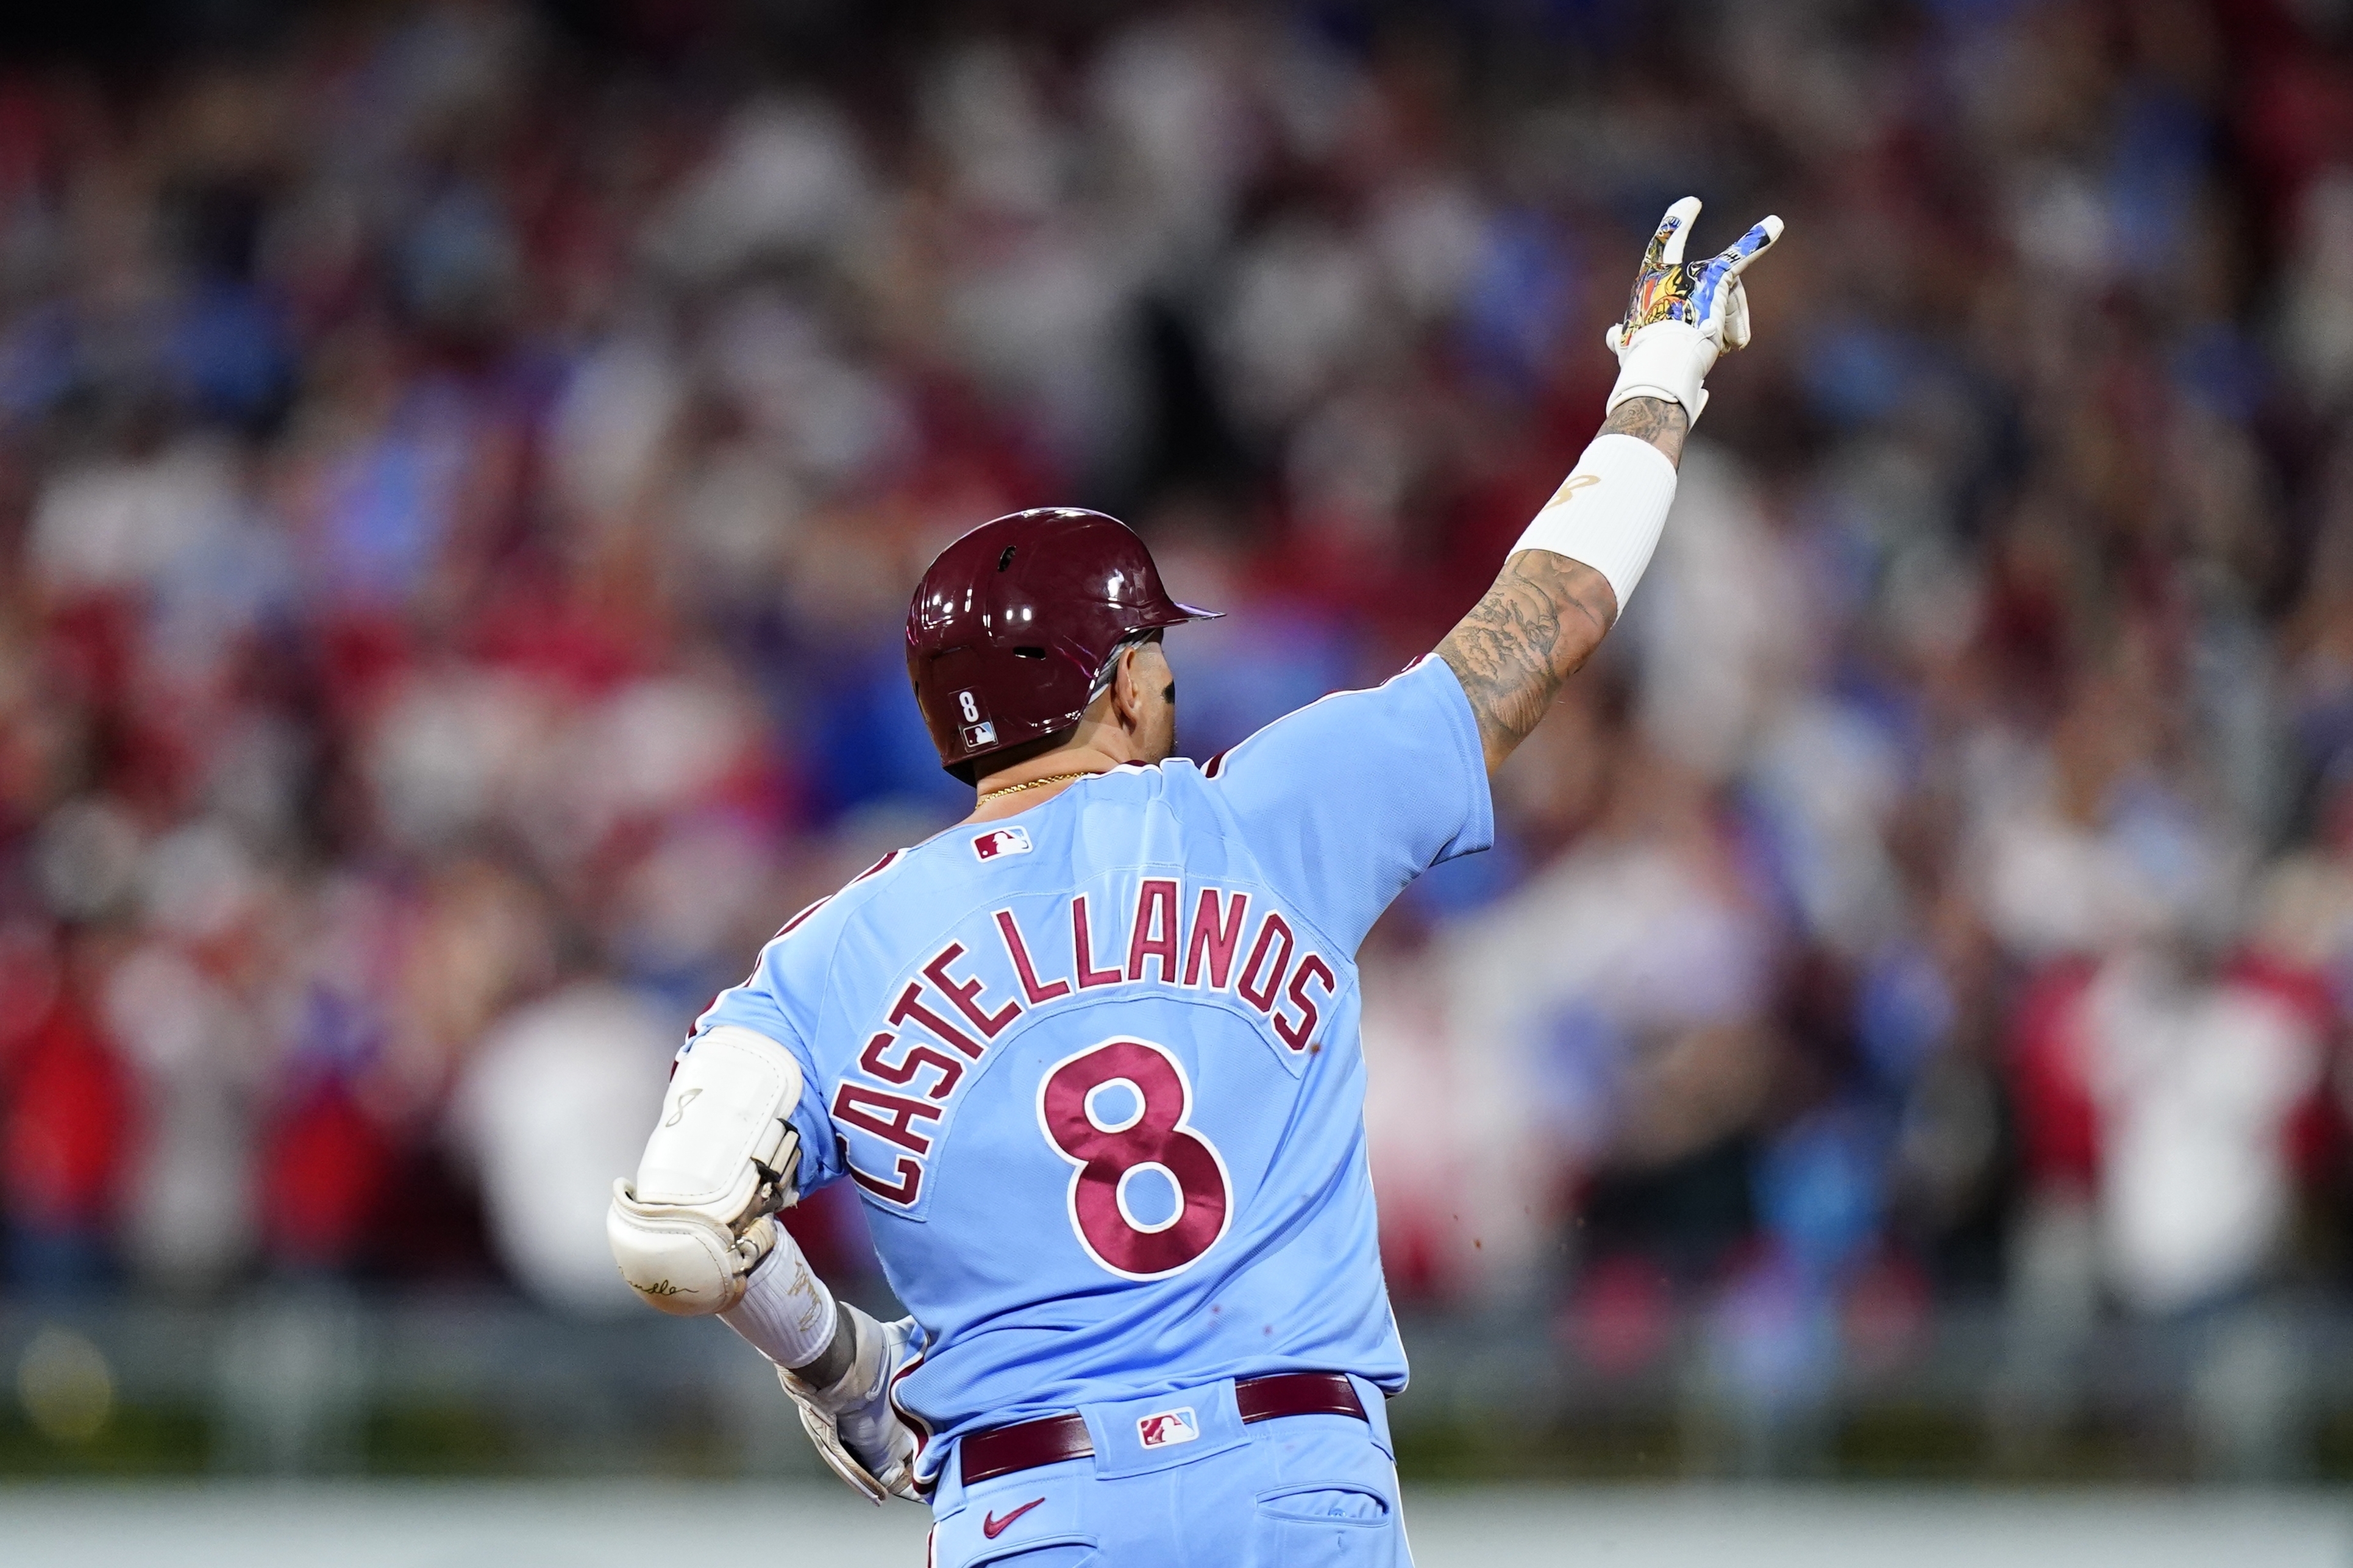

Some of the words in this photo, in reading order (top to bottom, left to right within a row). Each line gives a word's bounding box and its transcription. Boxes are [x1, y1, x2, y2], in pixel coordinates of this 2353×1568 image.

[959, 691, 979, 722] 8
[830, 876, 1336, 1210] CASTELLANOS
[1036, 1035, 1234, 1281] 8
